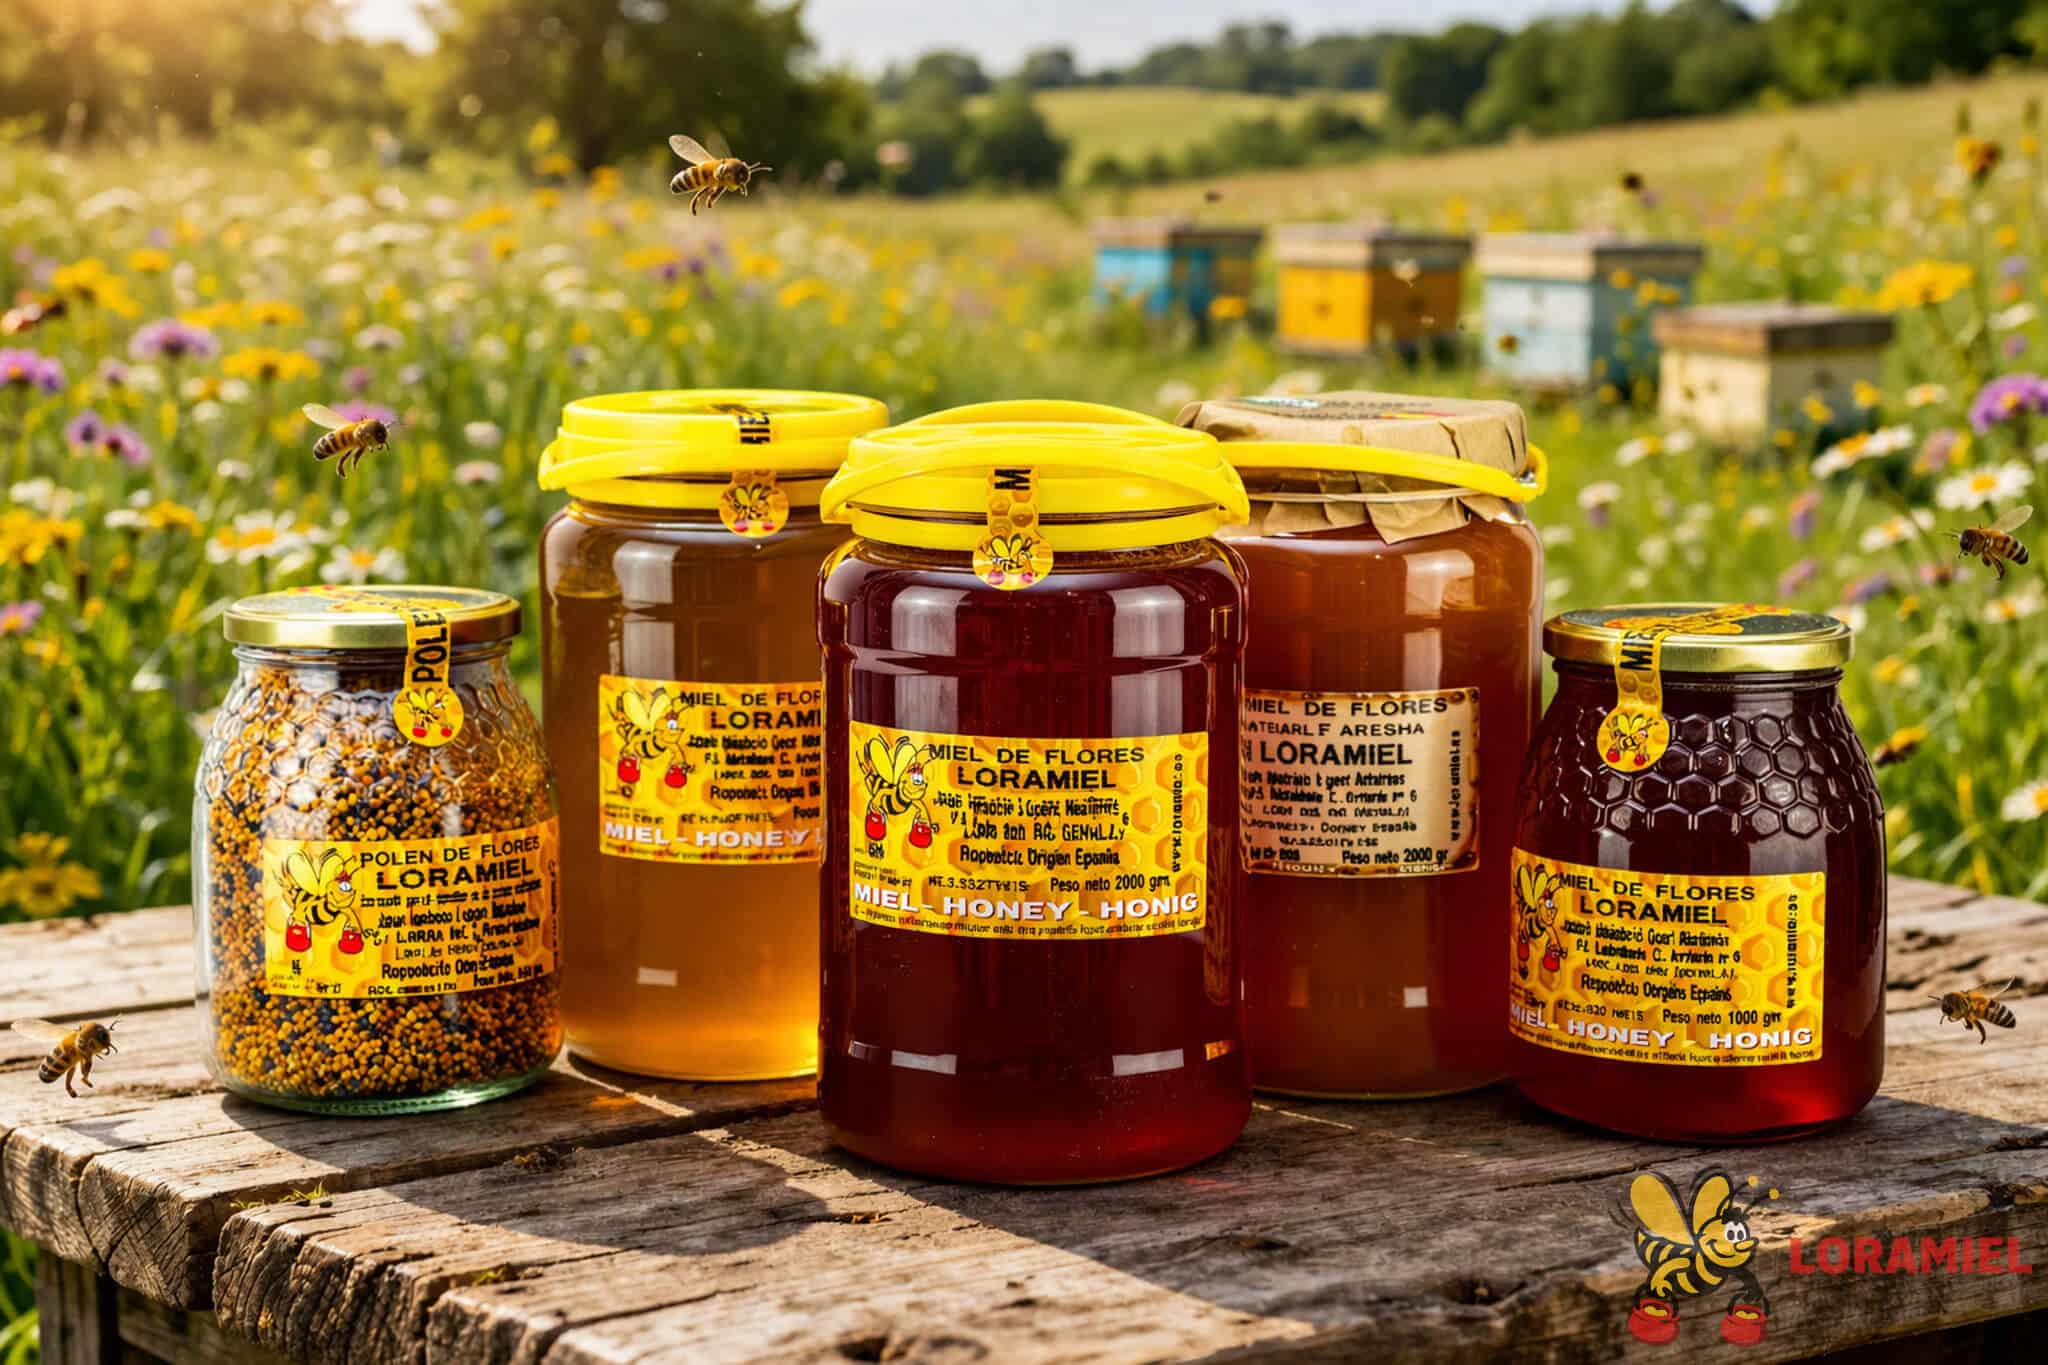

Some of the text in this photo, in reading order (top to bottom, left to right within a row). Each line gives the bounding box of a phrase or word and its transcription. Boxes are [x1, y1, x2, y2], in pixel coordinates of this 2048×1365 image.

[680, 691, 728, 707] MIEL
[741, 692, 768, 706] DE
[1304, 701, 1337, 717] DE
[1351, 697, 1448, 717] FLORES
[1340, 722, 1425, 737] ARESHA
[928, 743, 1145, 765] MIEL DE FLORES
[1260, 740, 1412, 766] LORAMIEL
[957, 766, 1117, 790] LORAMIEL
[605, 821, 671, 845] MIEL
[695, 829, 810, 848] HONEY
[360, 835, 540, 867] POLEN DE FLORES
[1342, 850, 1370, 865] Peso
[1374, 850, 1399, 864] neto
[1403, 848, 1432, 863] 2000
[376, 858, 534, 890] LORAMIEL
[1051, 877, 1079, 892] Peso
[1085, 876, 1111, 891] neto
[1115, 874, 1144, 890] 2000
[1559, 873, 1756, 901] MIEL DE FLORES
[855, 882, 918, 912] MIEL
[943, 895, 1072, 921] HONEY
[1101, 892, 1199, 920] HONIG
[1580, 895, 1728, 924] LORAMIEL
[1511, 1003, 1546, 1027] MIEL
[1567, 1018, 1675, 1048] HONEY
[1709, 1028, 1813, 1049] HONIG
[1663, 1008, 1690, 1025] Peso
[1697, 1010, 1722, 1024] neto
[1728, 1010, 1758, 1025] 1000
